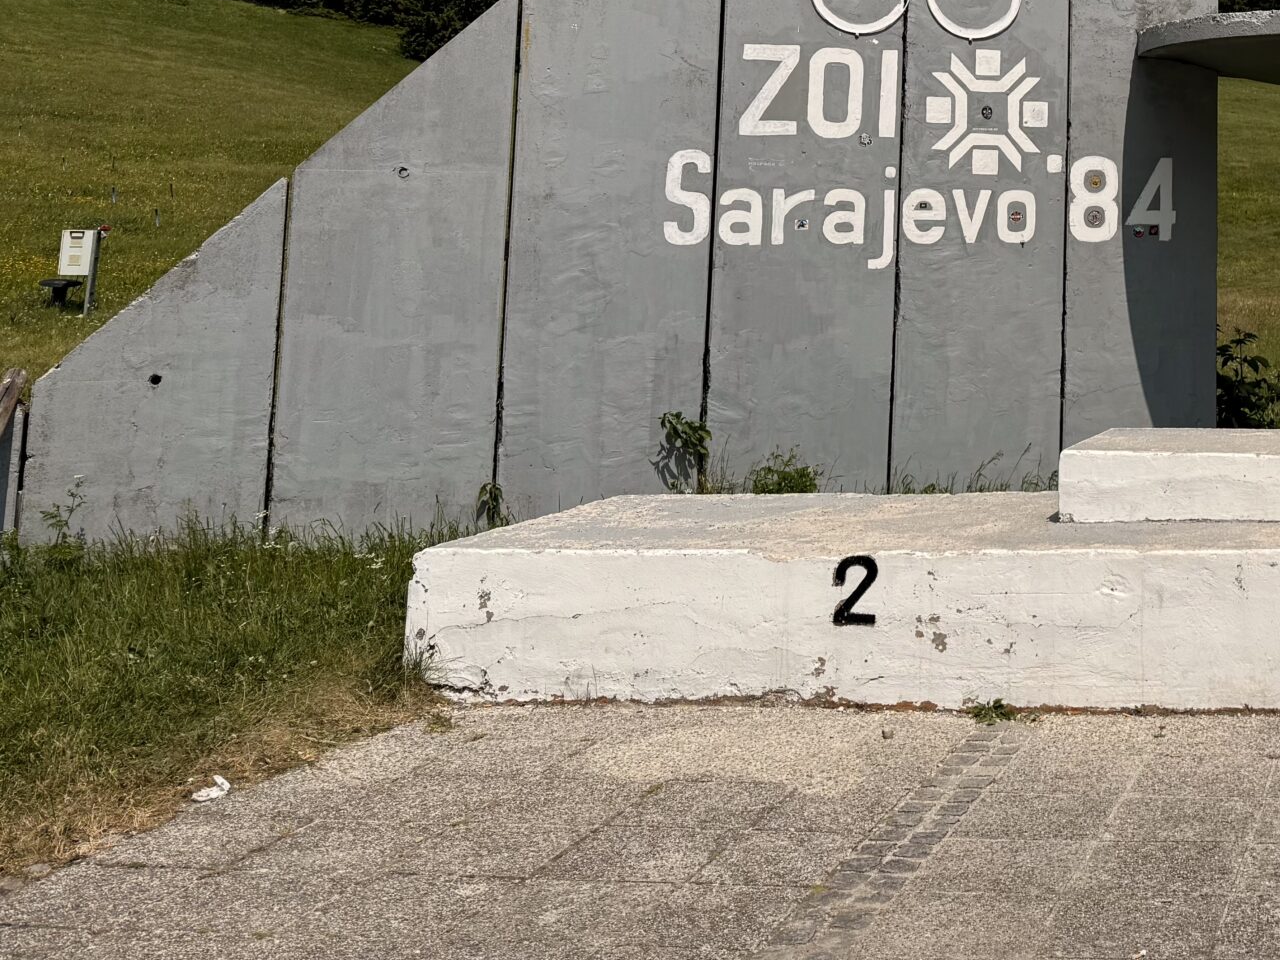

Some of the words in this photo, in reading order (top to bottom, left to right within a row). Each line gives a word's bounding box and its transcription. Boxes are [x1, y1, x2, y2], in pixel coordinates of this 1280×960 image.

[739, 43, 899, 139] ZOI
[663, 148, 1037, 270] Sarajevo
[831, 554, 879, 627] 2
